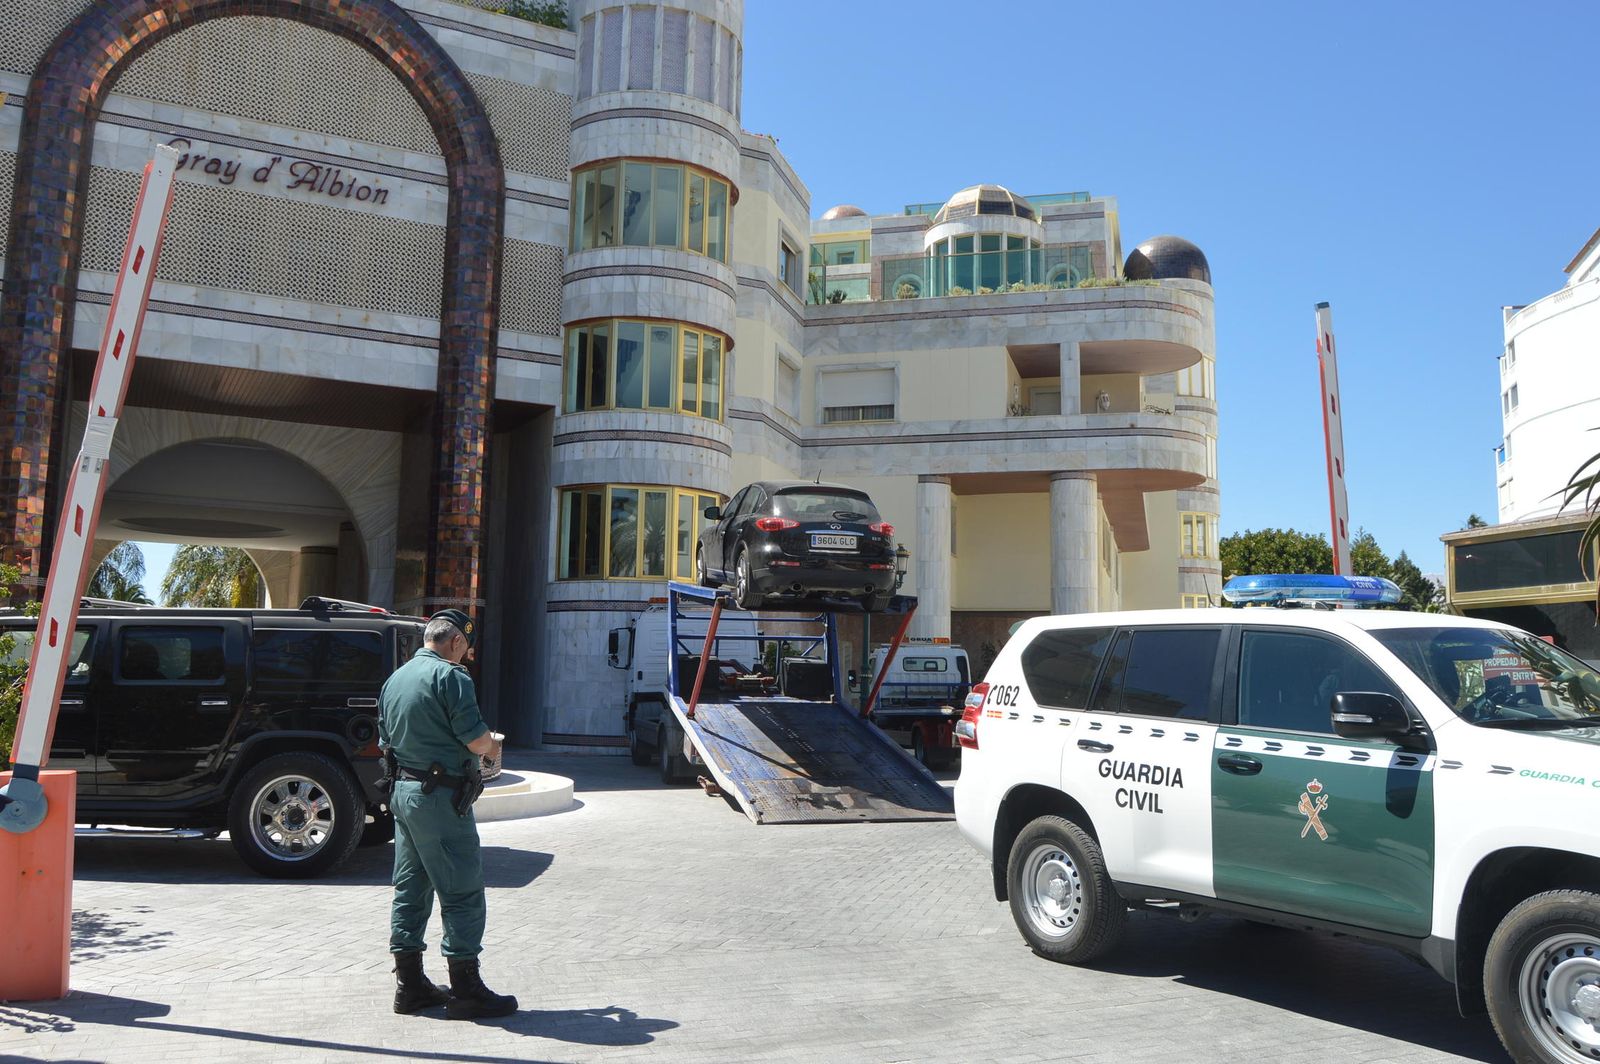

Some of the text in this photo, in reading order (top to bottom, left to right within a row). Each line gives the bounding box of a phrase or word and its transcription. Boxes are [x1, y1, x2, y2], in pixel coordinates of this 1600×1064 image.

[817, 536, 855, 546] 9604 GLC
[996, 685, 1020, 707] 062
[1098, 758, 1184, 789] GUARDIA
[1519, 769, 1585, 786] GUARDIA
[1115, 787, 1164, 814] CIVIL
